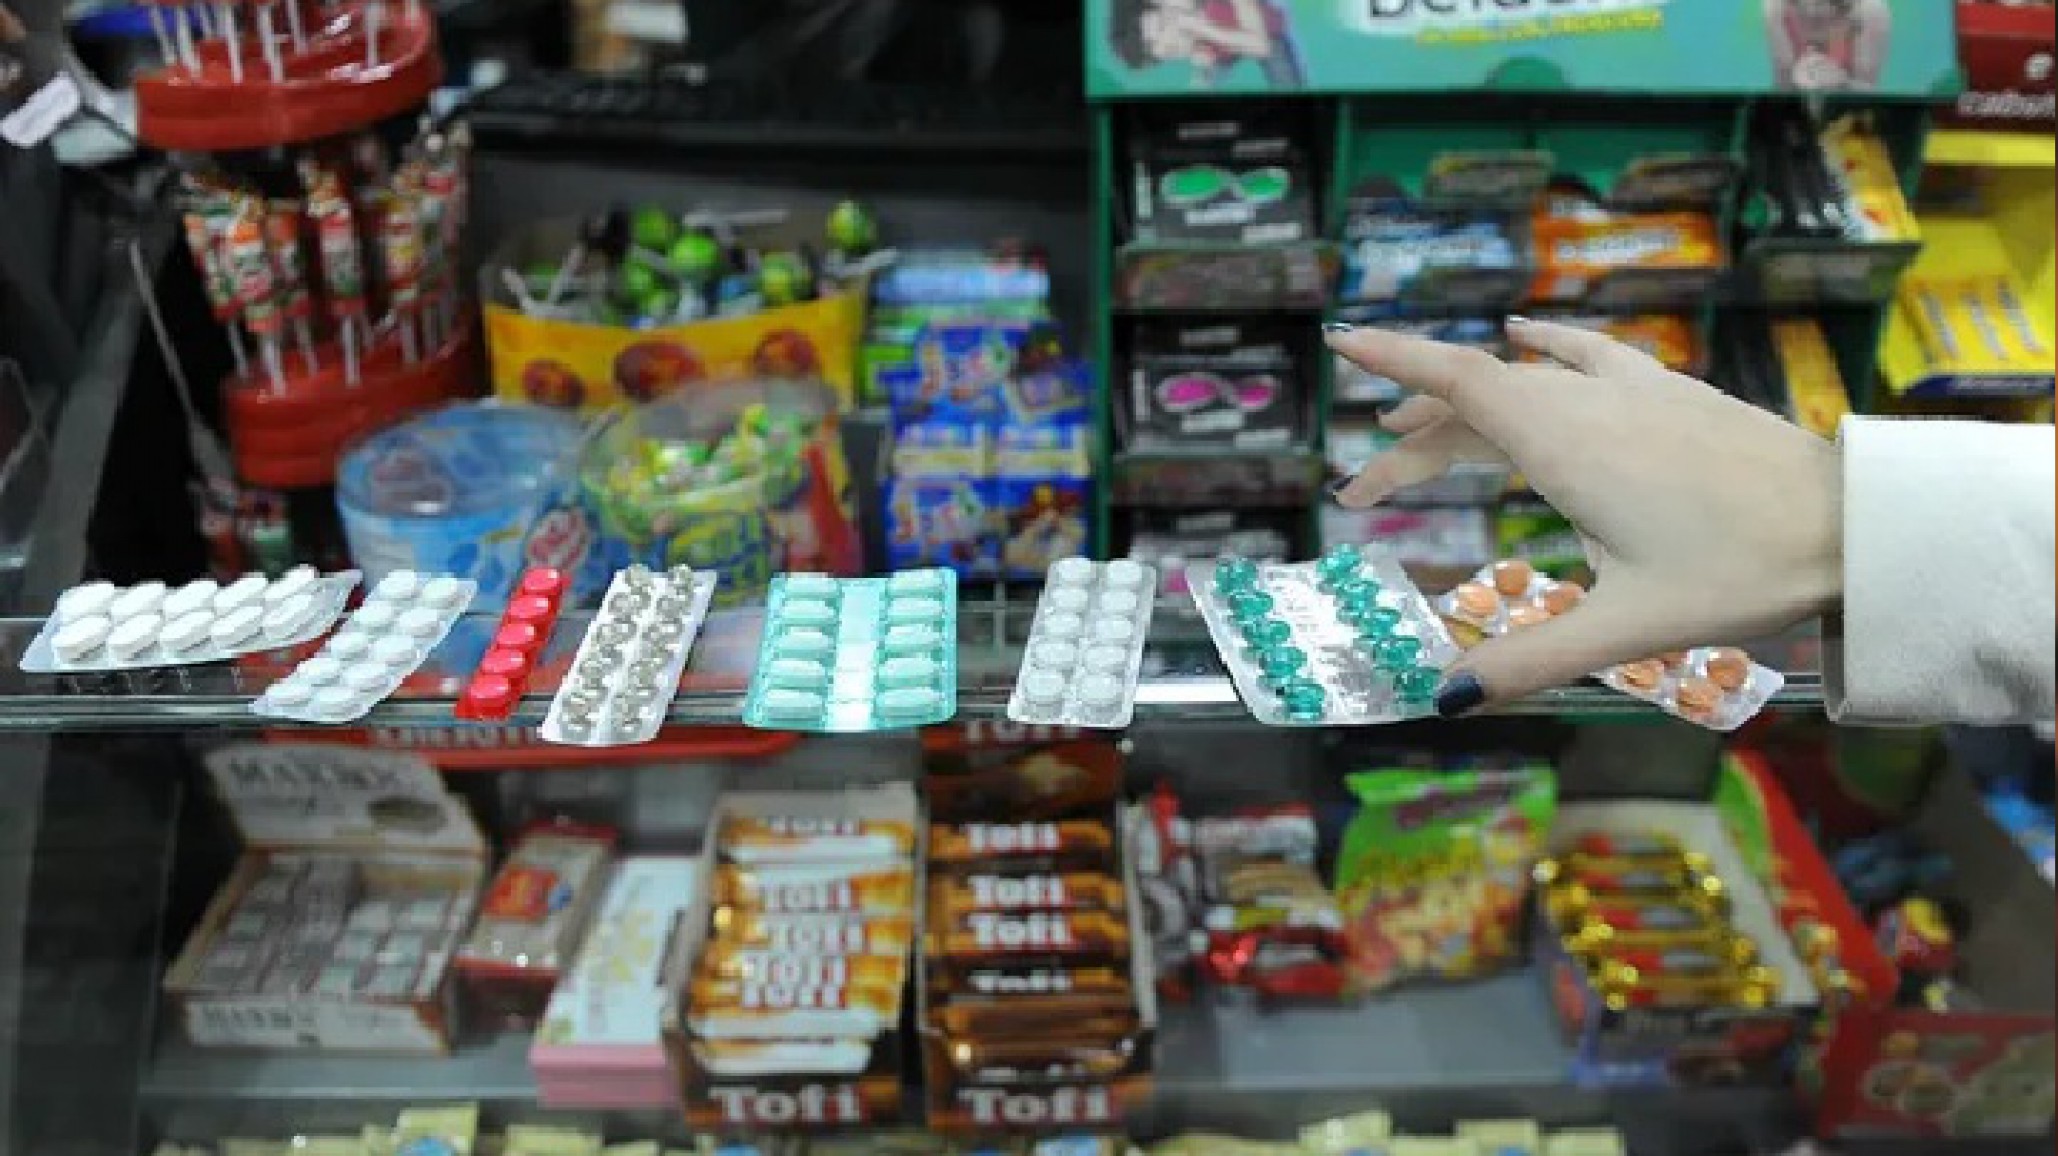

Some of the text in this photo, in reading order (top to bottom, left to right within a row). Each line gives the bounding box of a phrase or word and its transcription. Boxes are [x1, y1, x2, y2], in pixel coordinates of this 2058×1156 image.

[968, 874, 1066, 906] Tofi
[968, 912, 1074, 949] Tofi
[706, 1083, 866, 1124] Tofi
[955, 1085, 1113, 1124] Tofi
